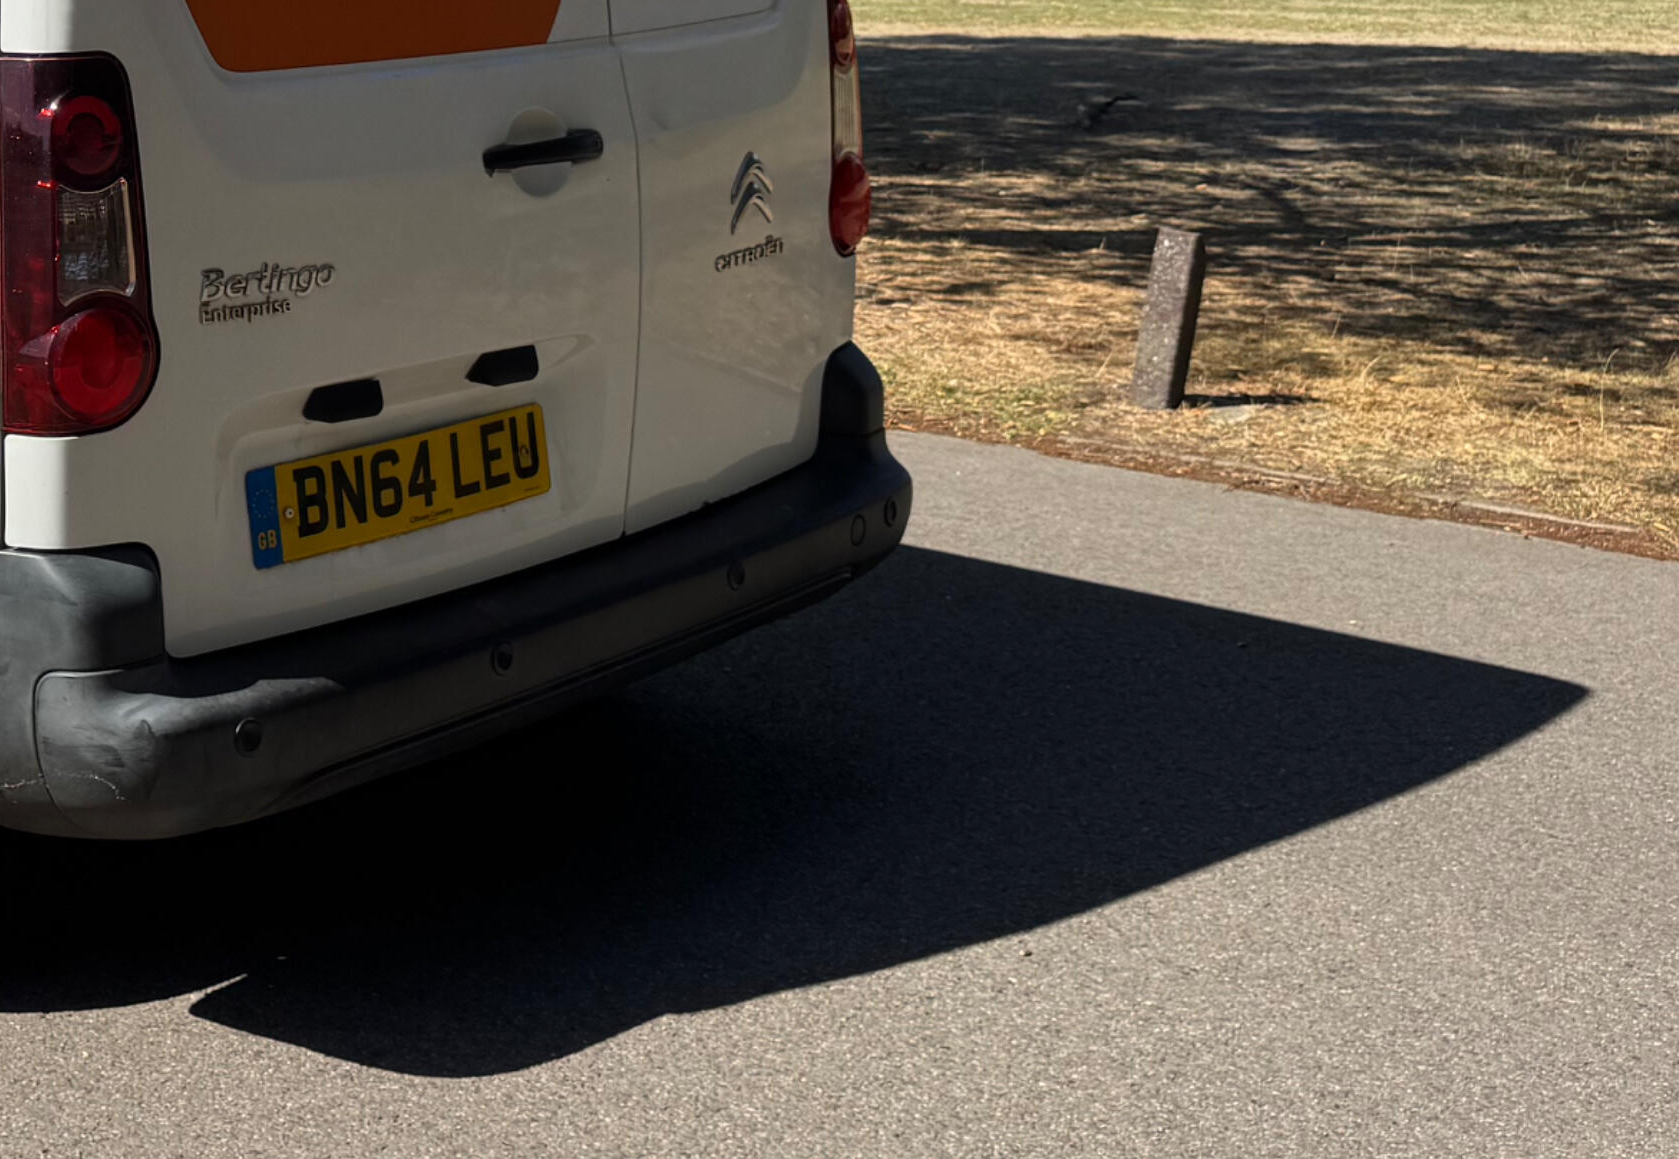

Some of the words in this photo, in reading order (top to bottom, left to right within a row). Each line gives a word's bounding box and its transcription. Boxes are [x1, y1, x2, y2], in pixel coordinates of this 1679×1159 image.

[200, 261, 336, 301] Berlingo
[199, 296, 291, 324] Enterprise
[292, 440, 437, 538] BN64
[449, 411, 540, 499] LEU
[258, 529, 278, 551] GB
